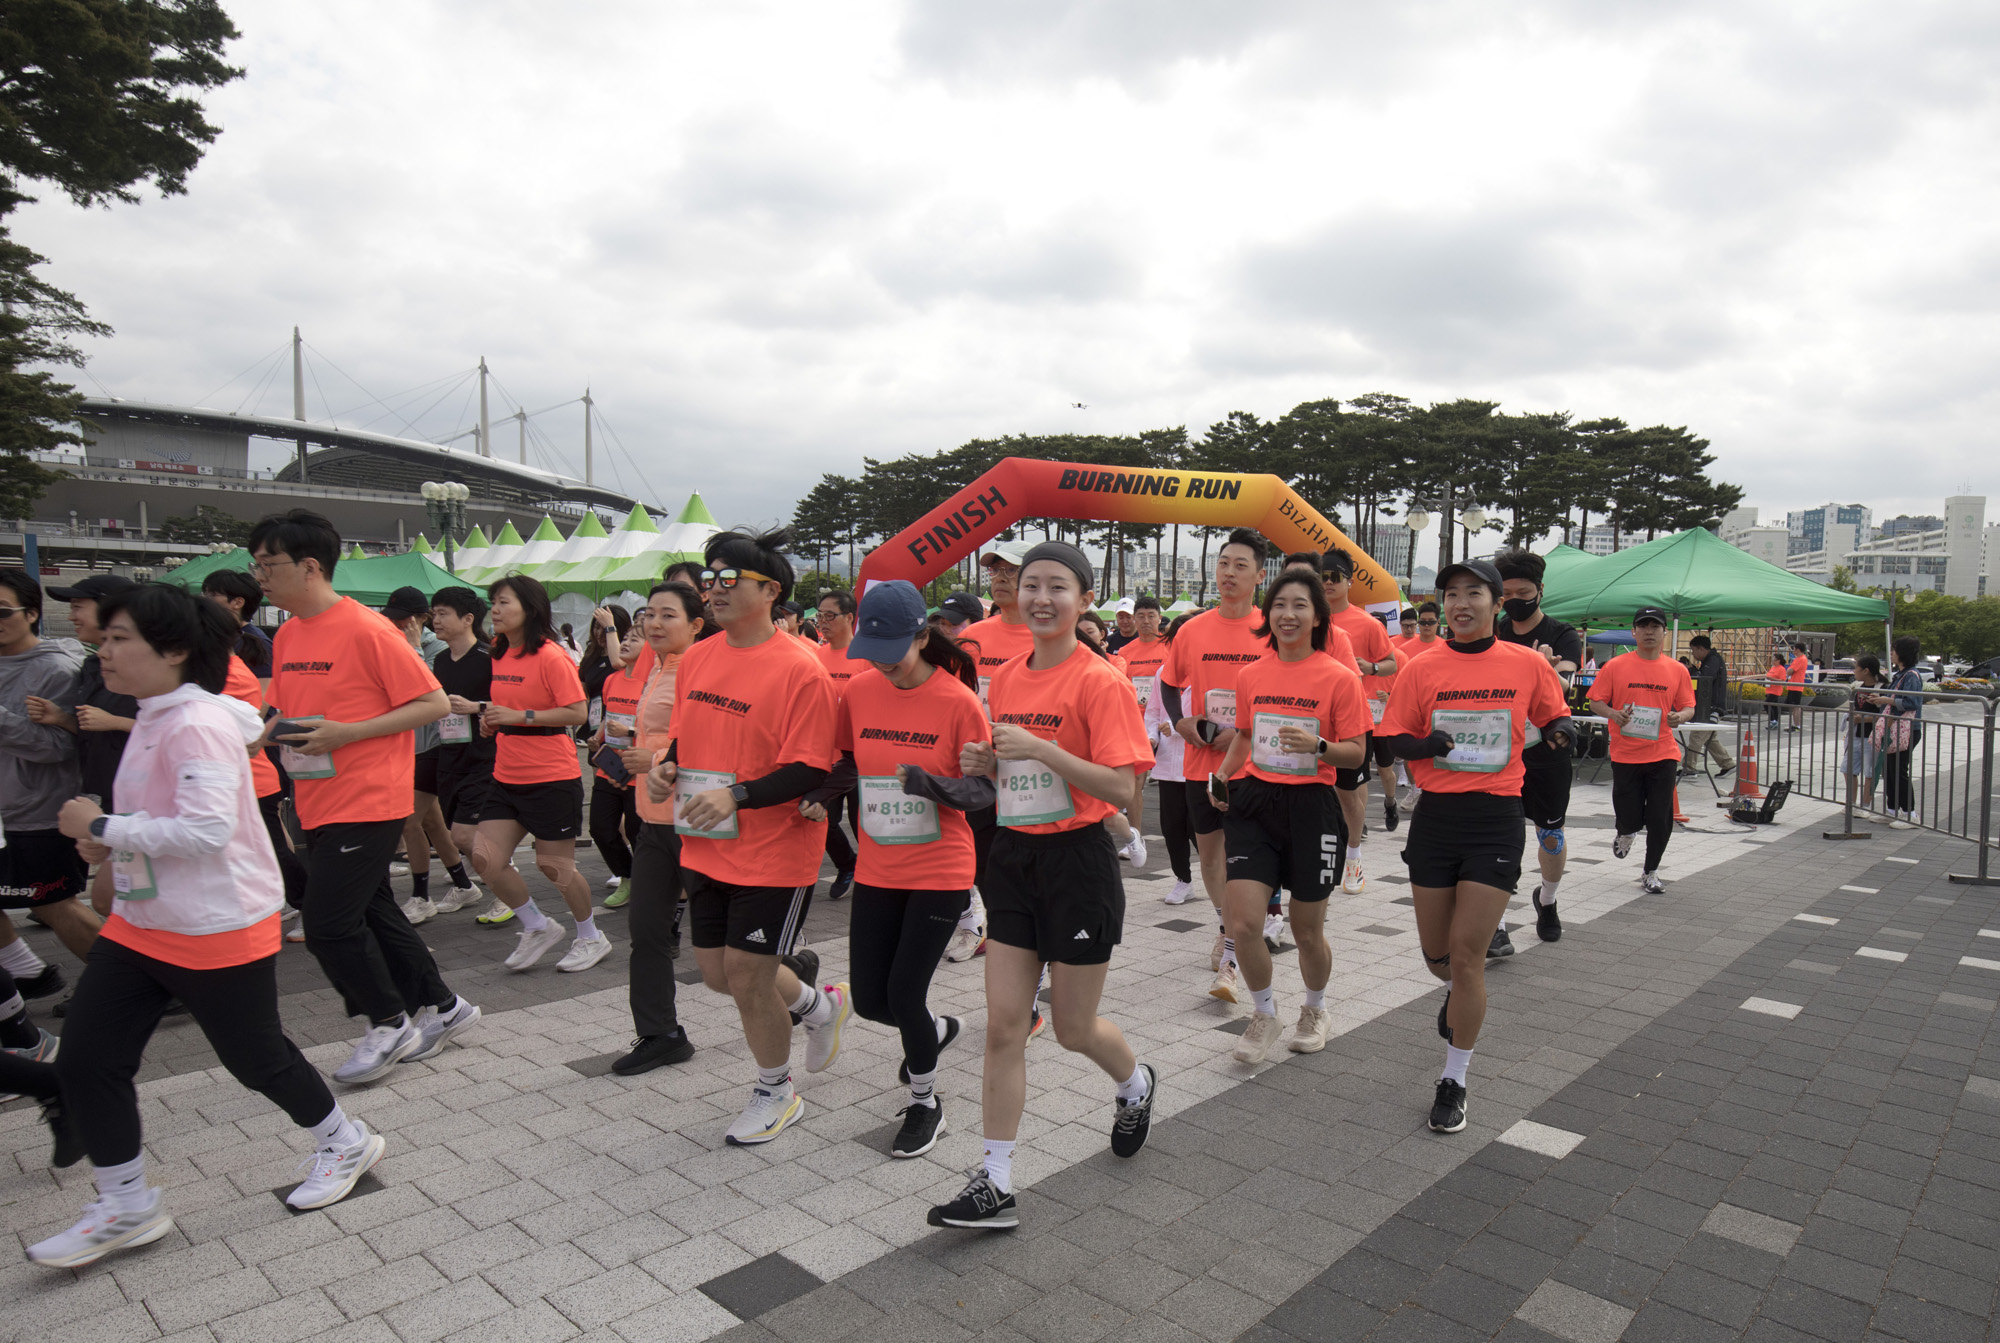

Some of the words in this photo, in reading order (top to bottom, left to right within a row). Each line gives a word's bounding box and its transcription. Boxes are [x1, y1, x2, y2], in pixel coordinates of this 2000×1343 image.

[1058, 469, 1180, 498] BURNING
[1185, 478, 1242, 500] RUN
[907, 485, 1008, 566] FINISH
[1278, 498, 1379, 591] BIZ.HANOOK
[978, 657, 1010, 667] BURN
[1202, 653, 1241, 662] BURNING
[1241, 654, 1261, 662] RUN
[311, 662, 334, 672] RUN
[1628, 682, 1655, 690] BURNING
[687, 690, 728, 708] BURNING
[727, 700, 752, 714] RUN
[1436, 689, 1490, 702] BURNING
[1490, 689, 1517, 700] RUN
[1253, 696, 1295, 706] BURNING
[1295, 698, 1320, 709] RUN
[1211, 706, 1219, 714] M
[1221, 706, 1237, 716] 70
[440, 718, 464, 728] 7335
[1033, 714, 1064, 728] RUN
[1633, 718, 1657, 727] 7054
[860, 728, 911, 743] BURNING
[909, 732, 940, 746] RUN
[1259, 735, 1268, 744] W
[1454, 732, 1502, 746] 8217
[1010, 772, 1053, 792] 8219
[867, 803, 877, 813] W
[881, 801, 926, 815] 8130
[1320, 833, 1338, 885] UFC
[746, 935, 768, 944] adidas
